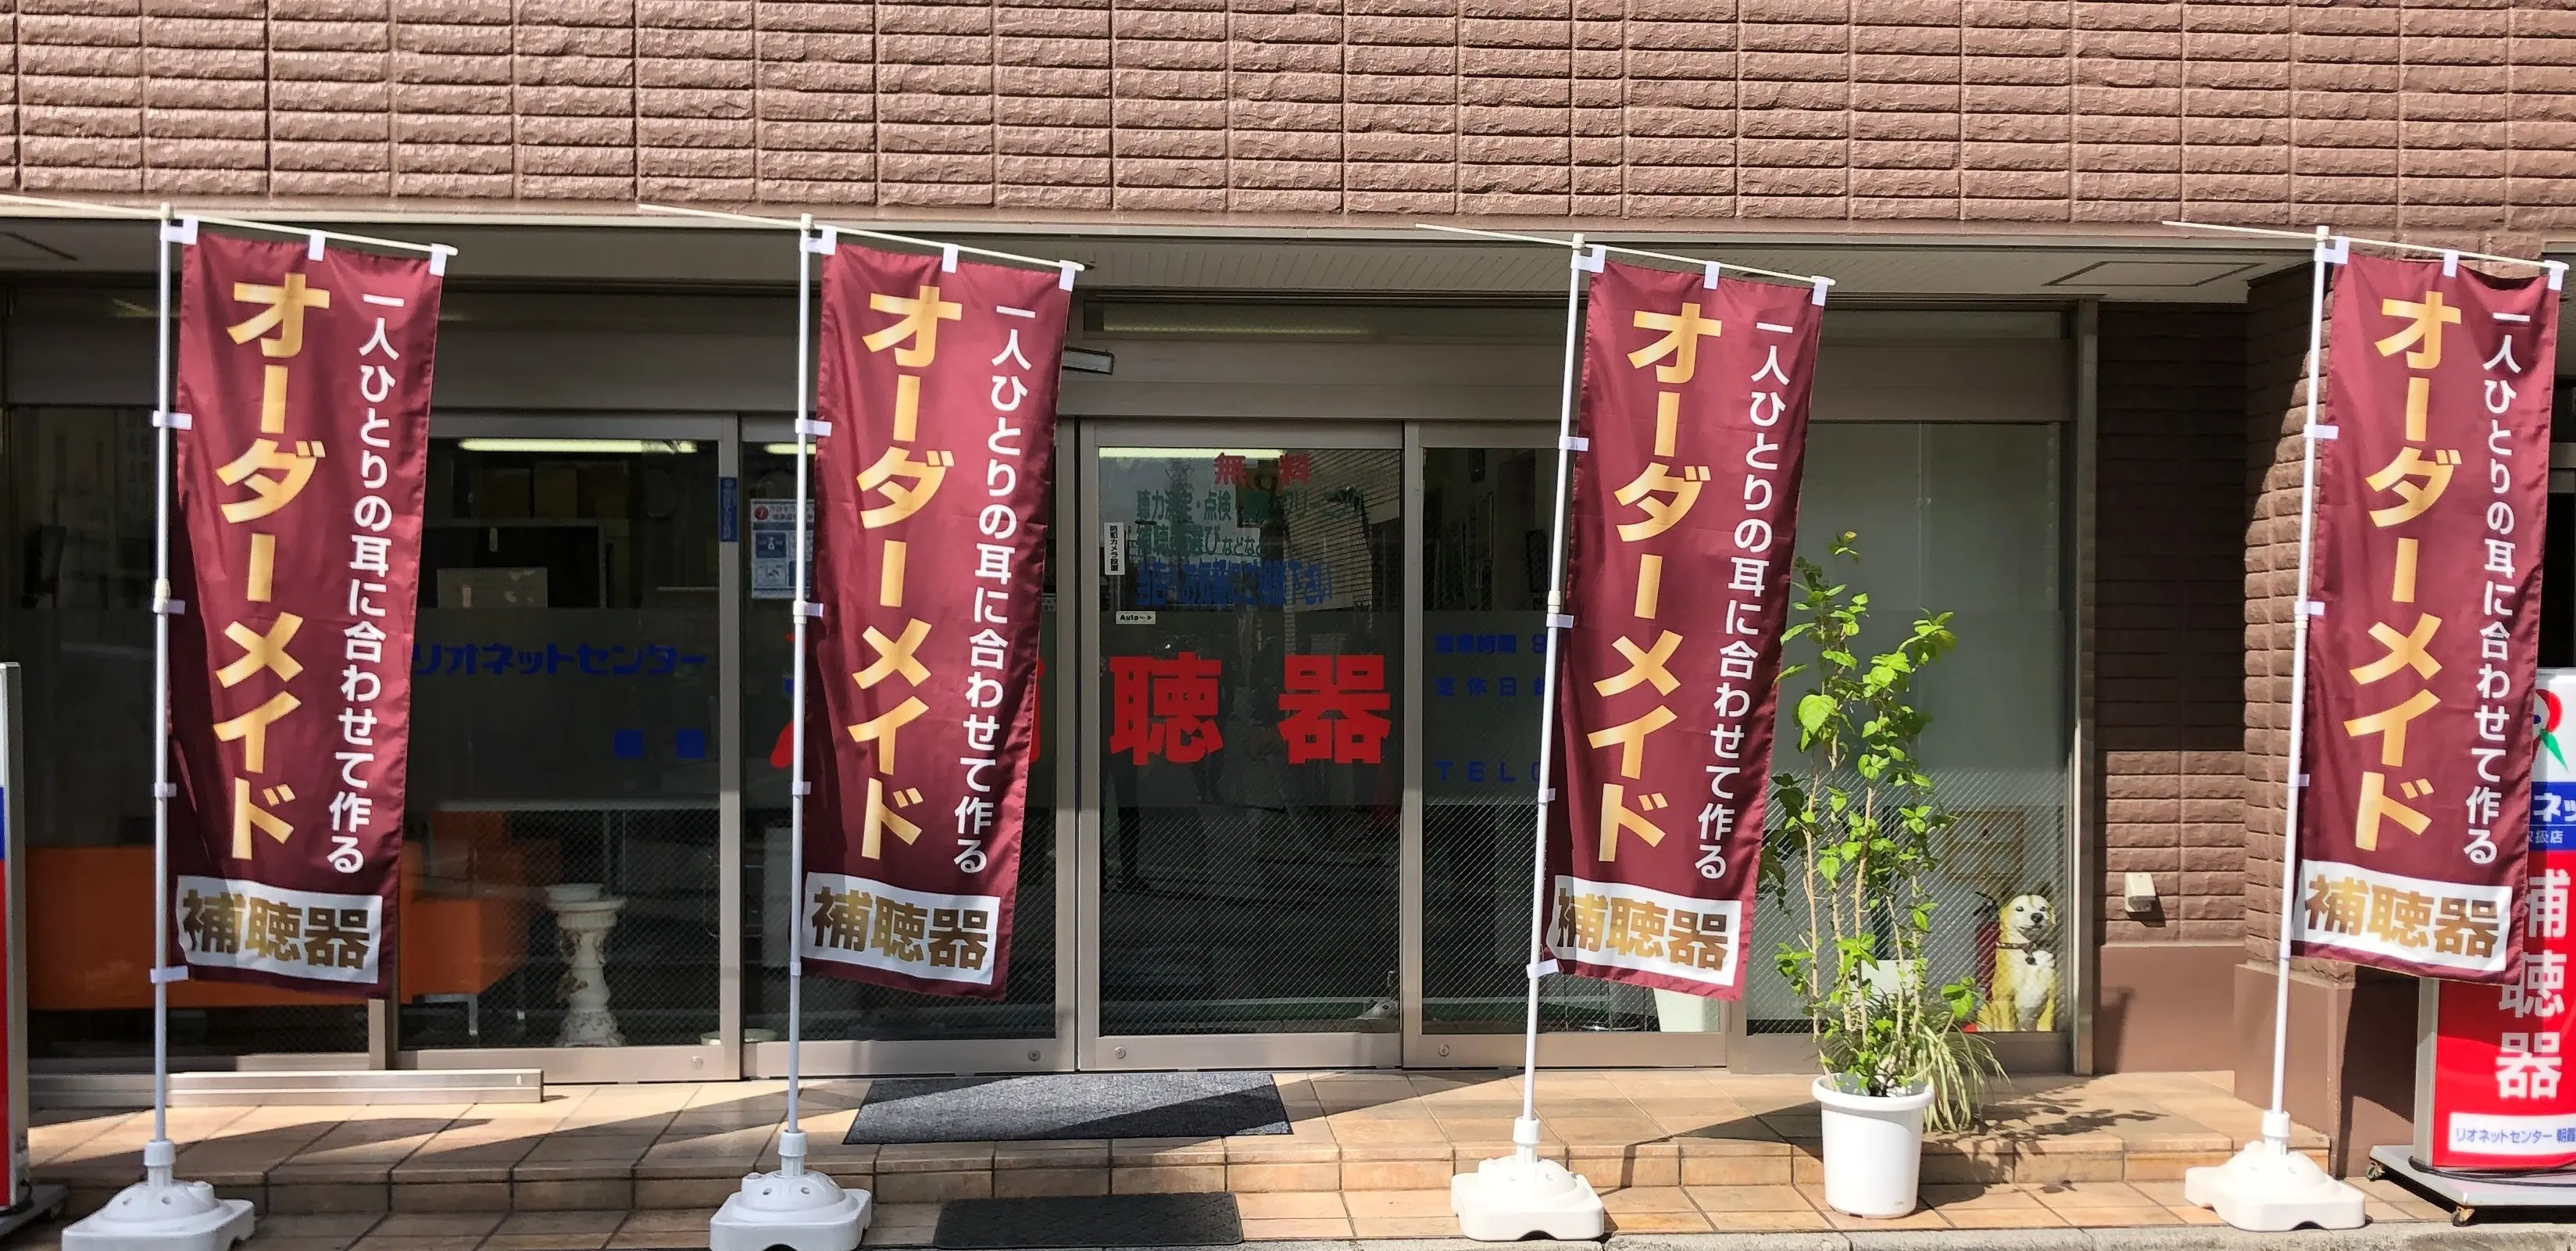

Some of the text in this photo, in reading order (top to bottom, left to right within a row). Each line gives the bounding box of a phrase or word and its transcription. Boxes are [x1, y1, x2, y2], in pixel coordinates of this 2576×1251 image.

[213, 273, 330, 860] オーダーメイド
[327, 293, 405, 874] 一人ひとりの耳に合わせて作る
[412, 642, 708, 675] リオネットセンター
[847, 285, 963, 860] オーダーメイド
[954, 305, 1036, 873] 一人ひとりの耳に合わせて作る
[1587, 302, 1723, 862] オーダーメイド
[1695, 321, 1794, 879] 一人ひとりの耳に合わせて作る
[2344, 291, 2463, 852] オーダーメイド
[2463, 312, 2531, 864] 一人ひとりの耳に合わせて作る
[183, 888, 370, 970] 補聴器
[812, 886, 990, 970] 補聴器
[1558, 888, 1728, 971] 補聴器
[2305, 874, 2499, 959] 補聴器
[2456, 1128, 2553, 1144] リオネットセンター
